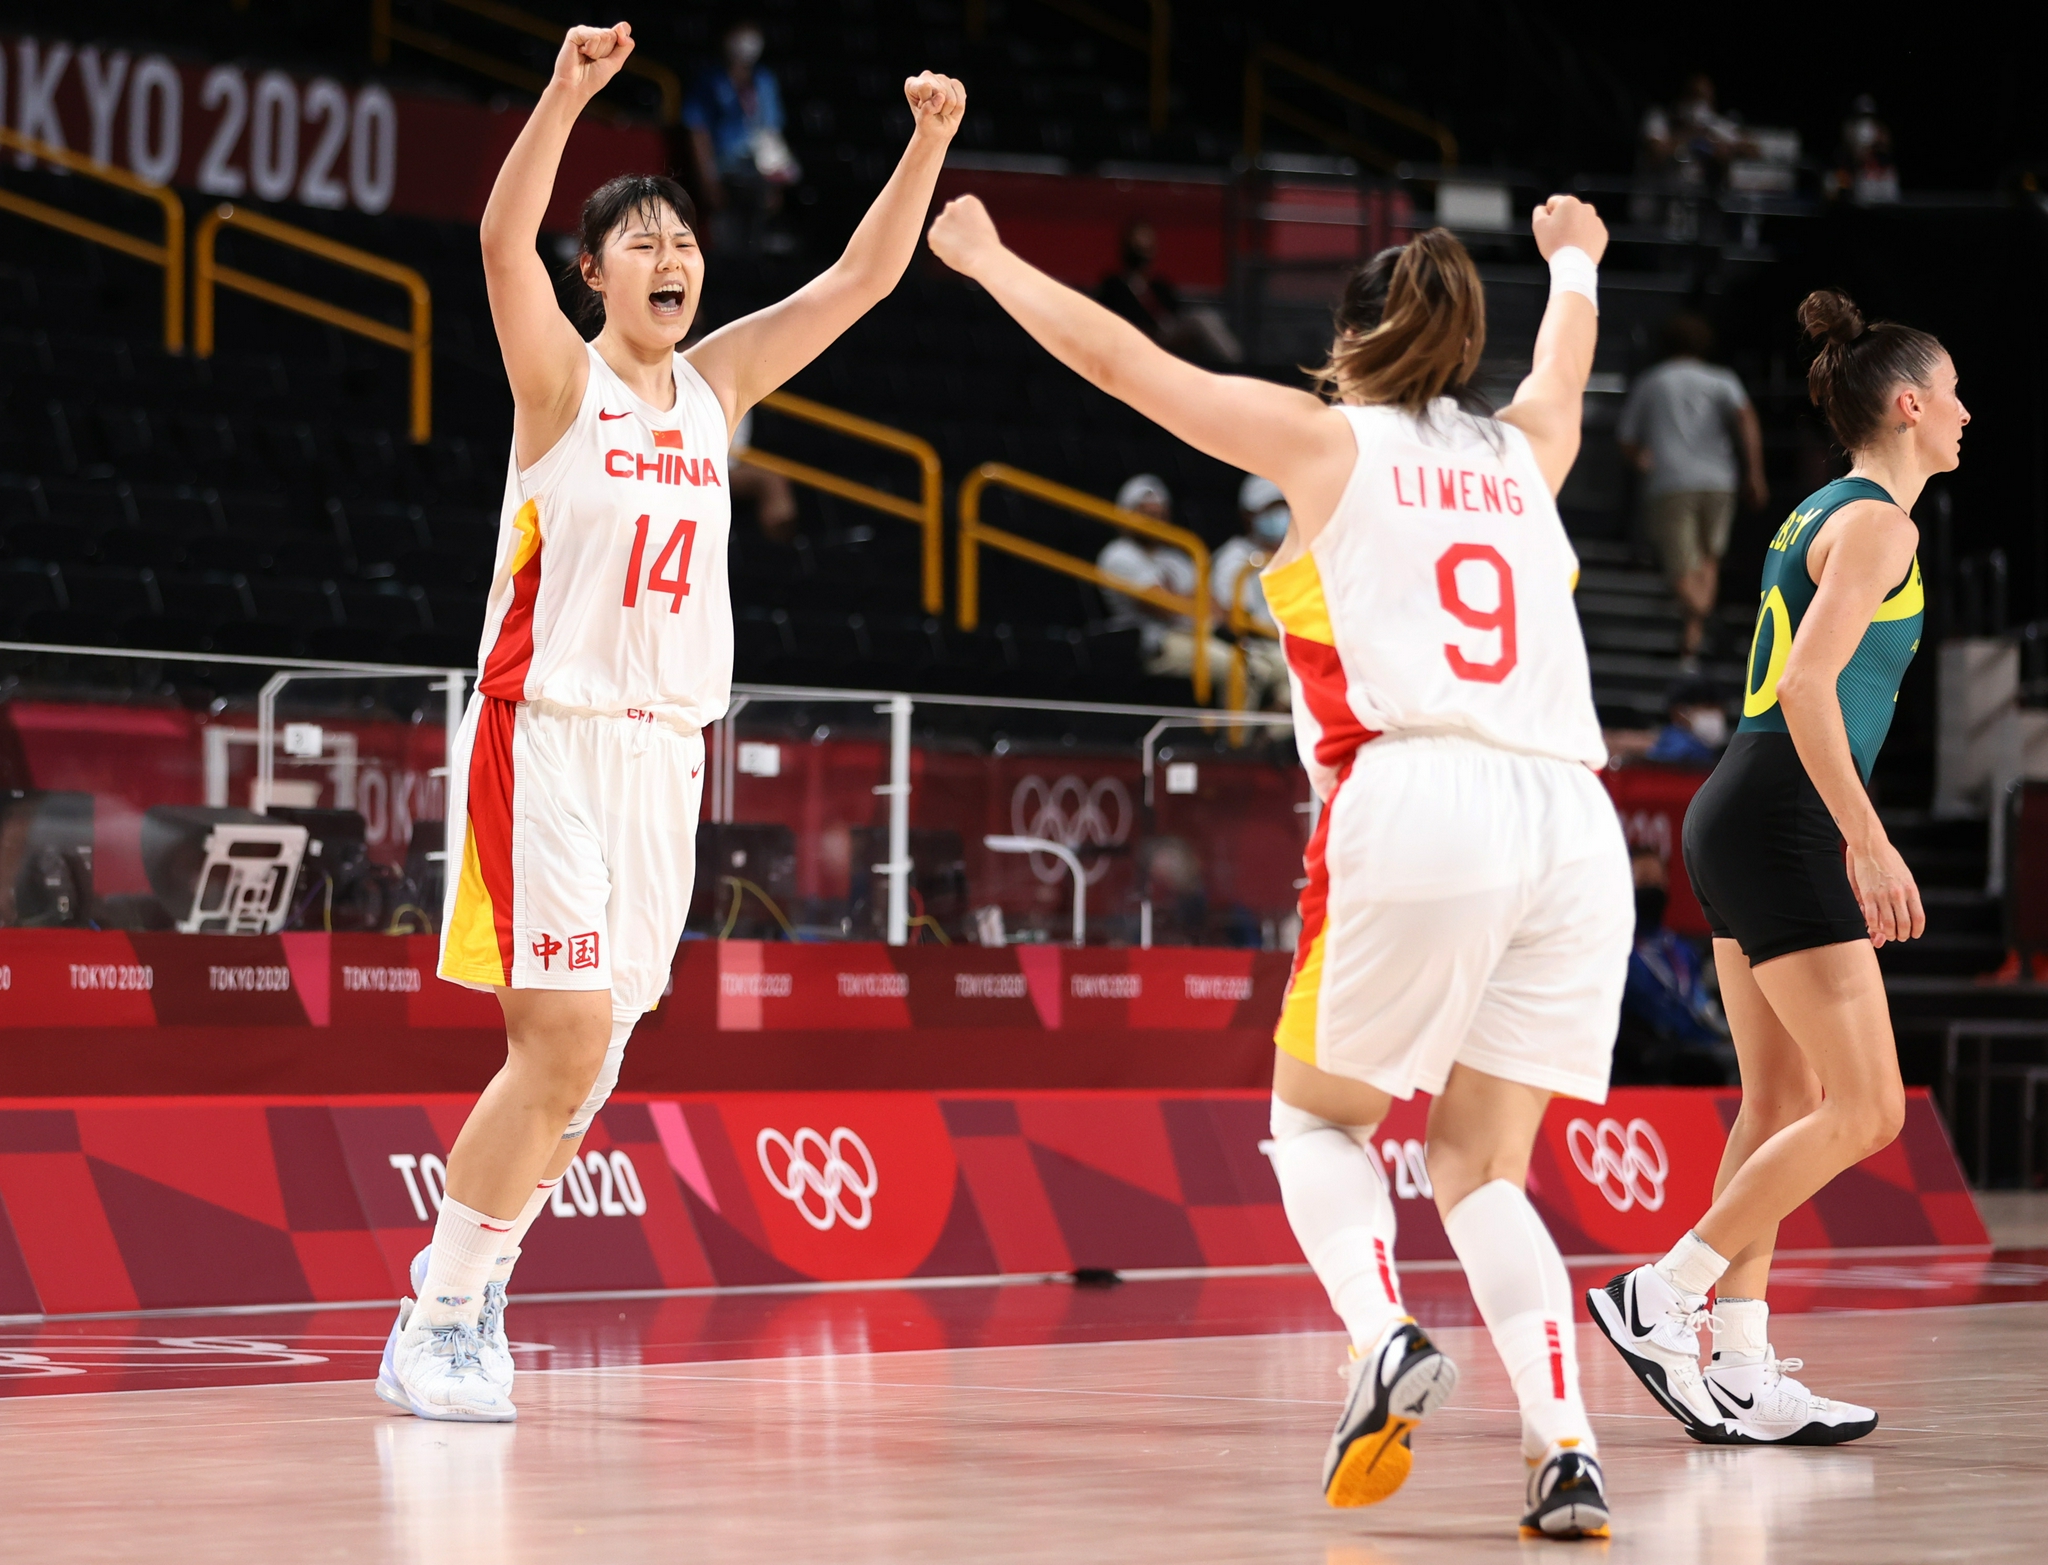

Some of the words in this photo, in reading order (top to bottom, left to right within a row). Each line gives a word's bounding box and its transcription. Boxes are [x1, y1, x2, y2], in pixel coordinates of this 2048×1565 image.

[0, 36, 183, 188] KYO
[198, 64, 397, 213] 2020
[605, 449, 721, 487] CHINA
[1393, 466, 1427, 508] LI
[1437, 467, 1523, 516] MENG
[622, 514, 697, 614] 14
[1435, 542, 1517, 685] 9
[532, 931, 600, 971] 中国
[69, 964, 117, 990] TOKYO
[118, 965, 154, 990] 2020
[208, 966, 255, 991] TOKYO
[256, 966, 290, 991] 2020
[342, 966, 387, 992] TOKYO
[387, 967, 421, 992] 2020
[1367, 1138, 1434, 1199] 20
